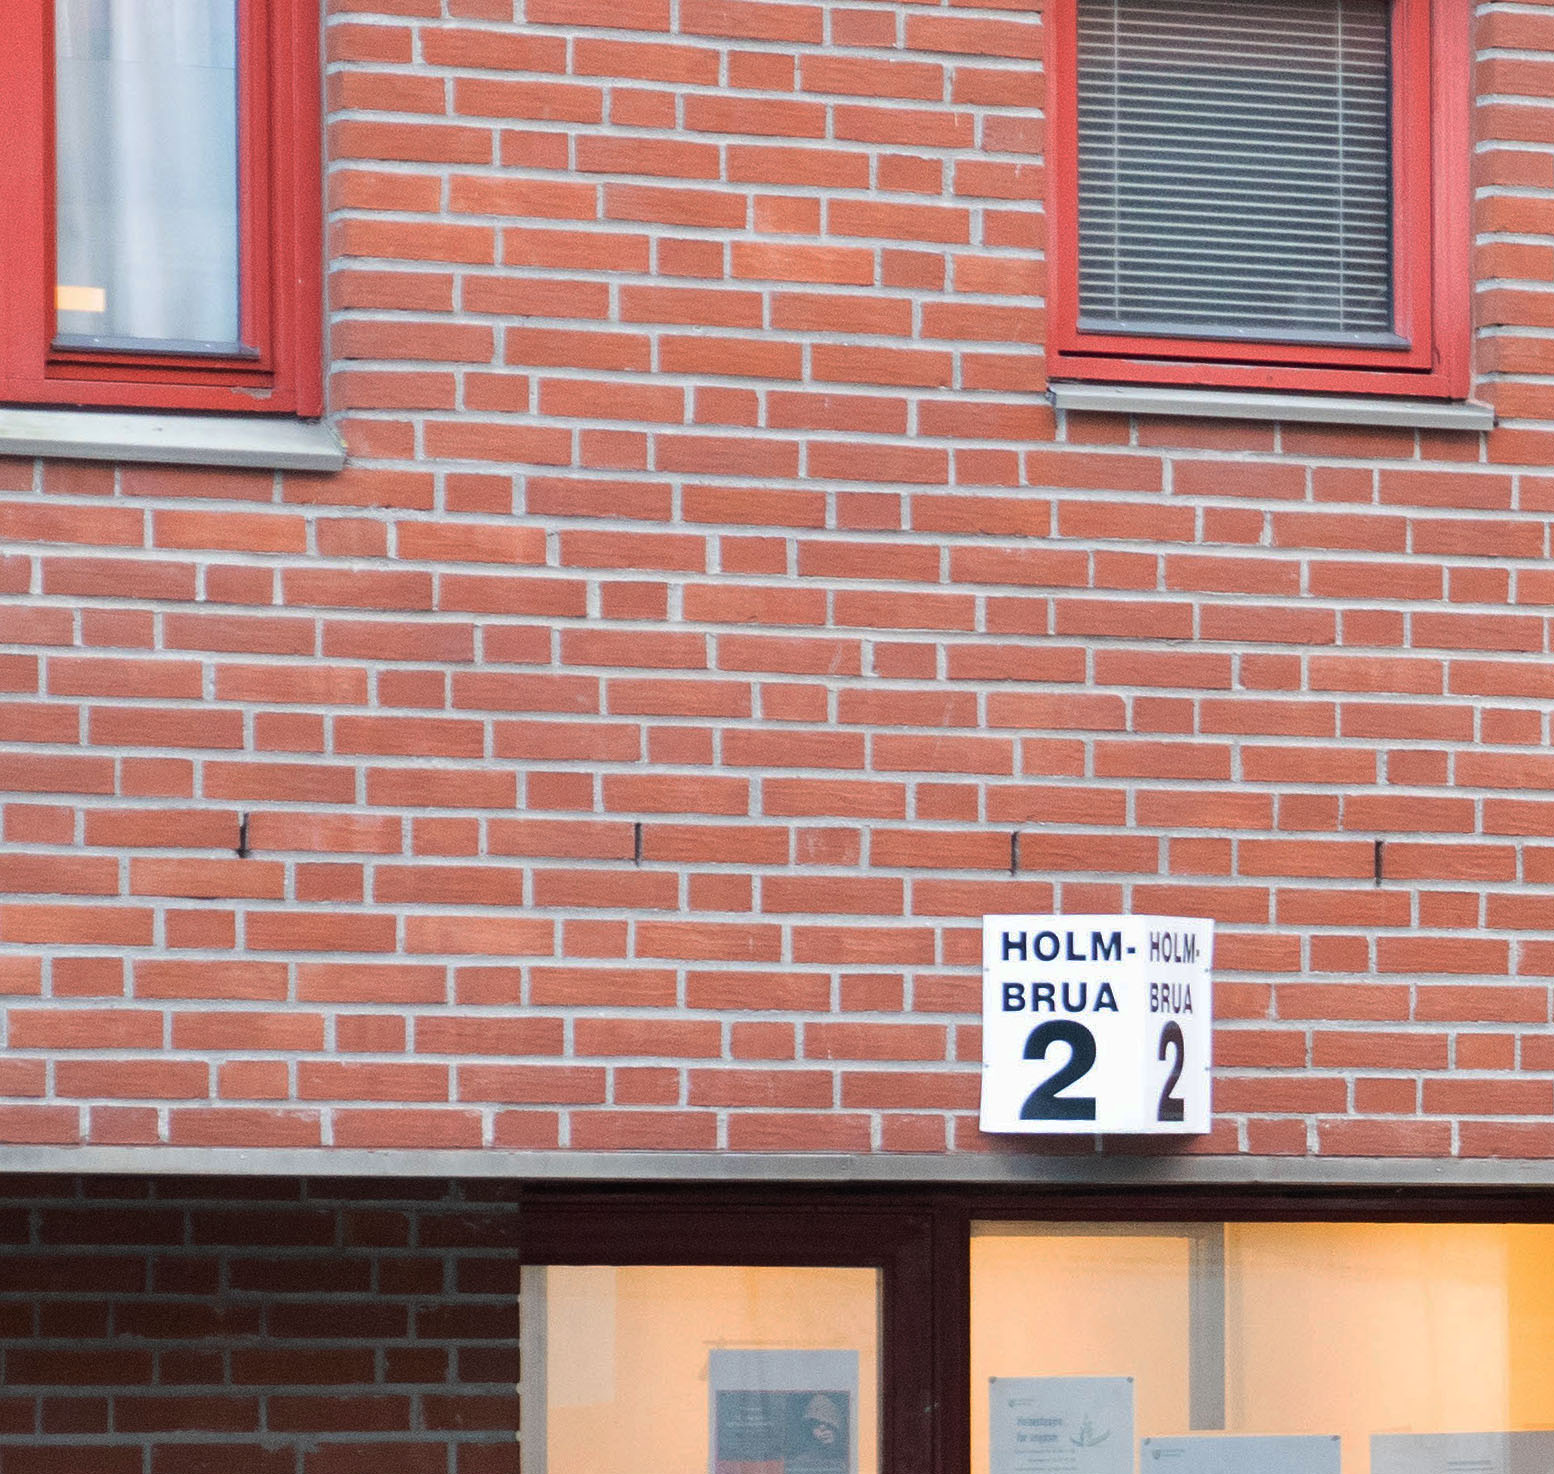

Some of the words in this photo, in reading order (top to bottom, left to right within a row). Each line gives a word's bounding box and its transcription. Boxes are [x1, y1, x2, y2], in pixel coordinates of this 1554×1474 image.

[1001, 930, 1136, 961] HOLM-
[1149, 931, 1200, 964] HOLM-
[1001, 982, 1119, 1013] BRUA
[1149, 983, 1193, 1014] BRUA
[1019, 1019, 1097, 1121] 2
[1157, 1020, 1185, 1122] 2
